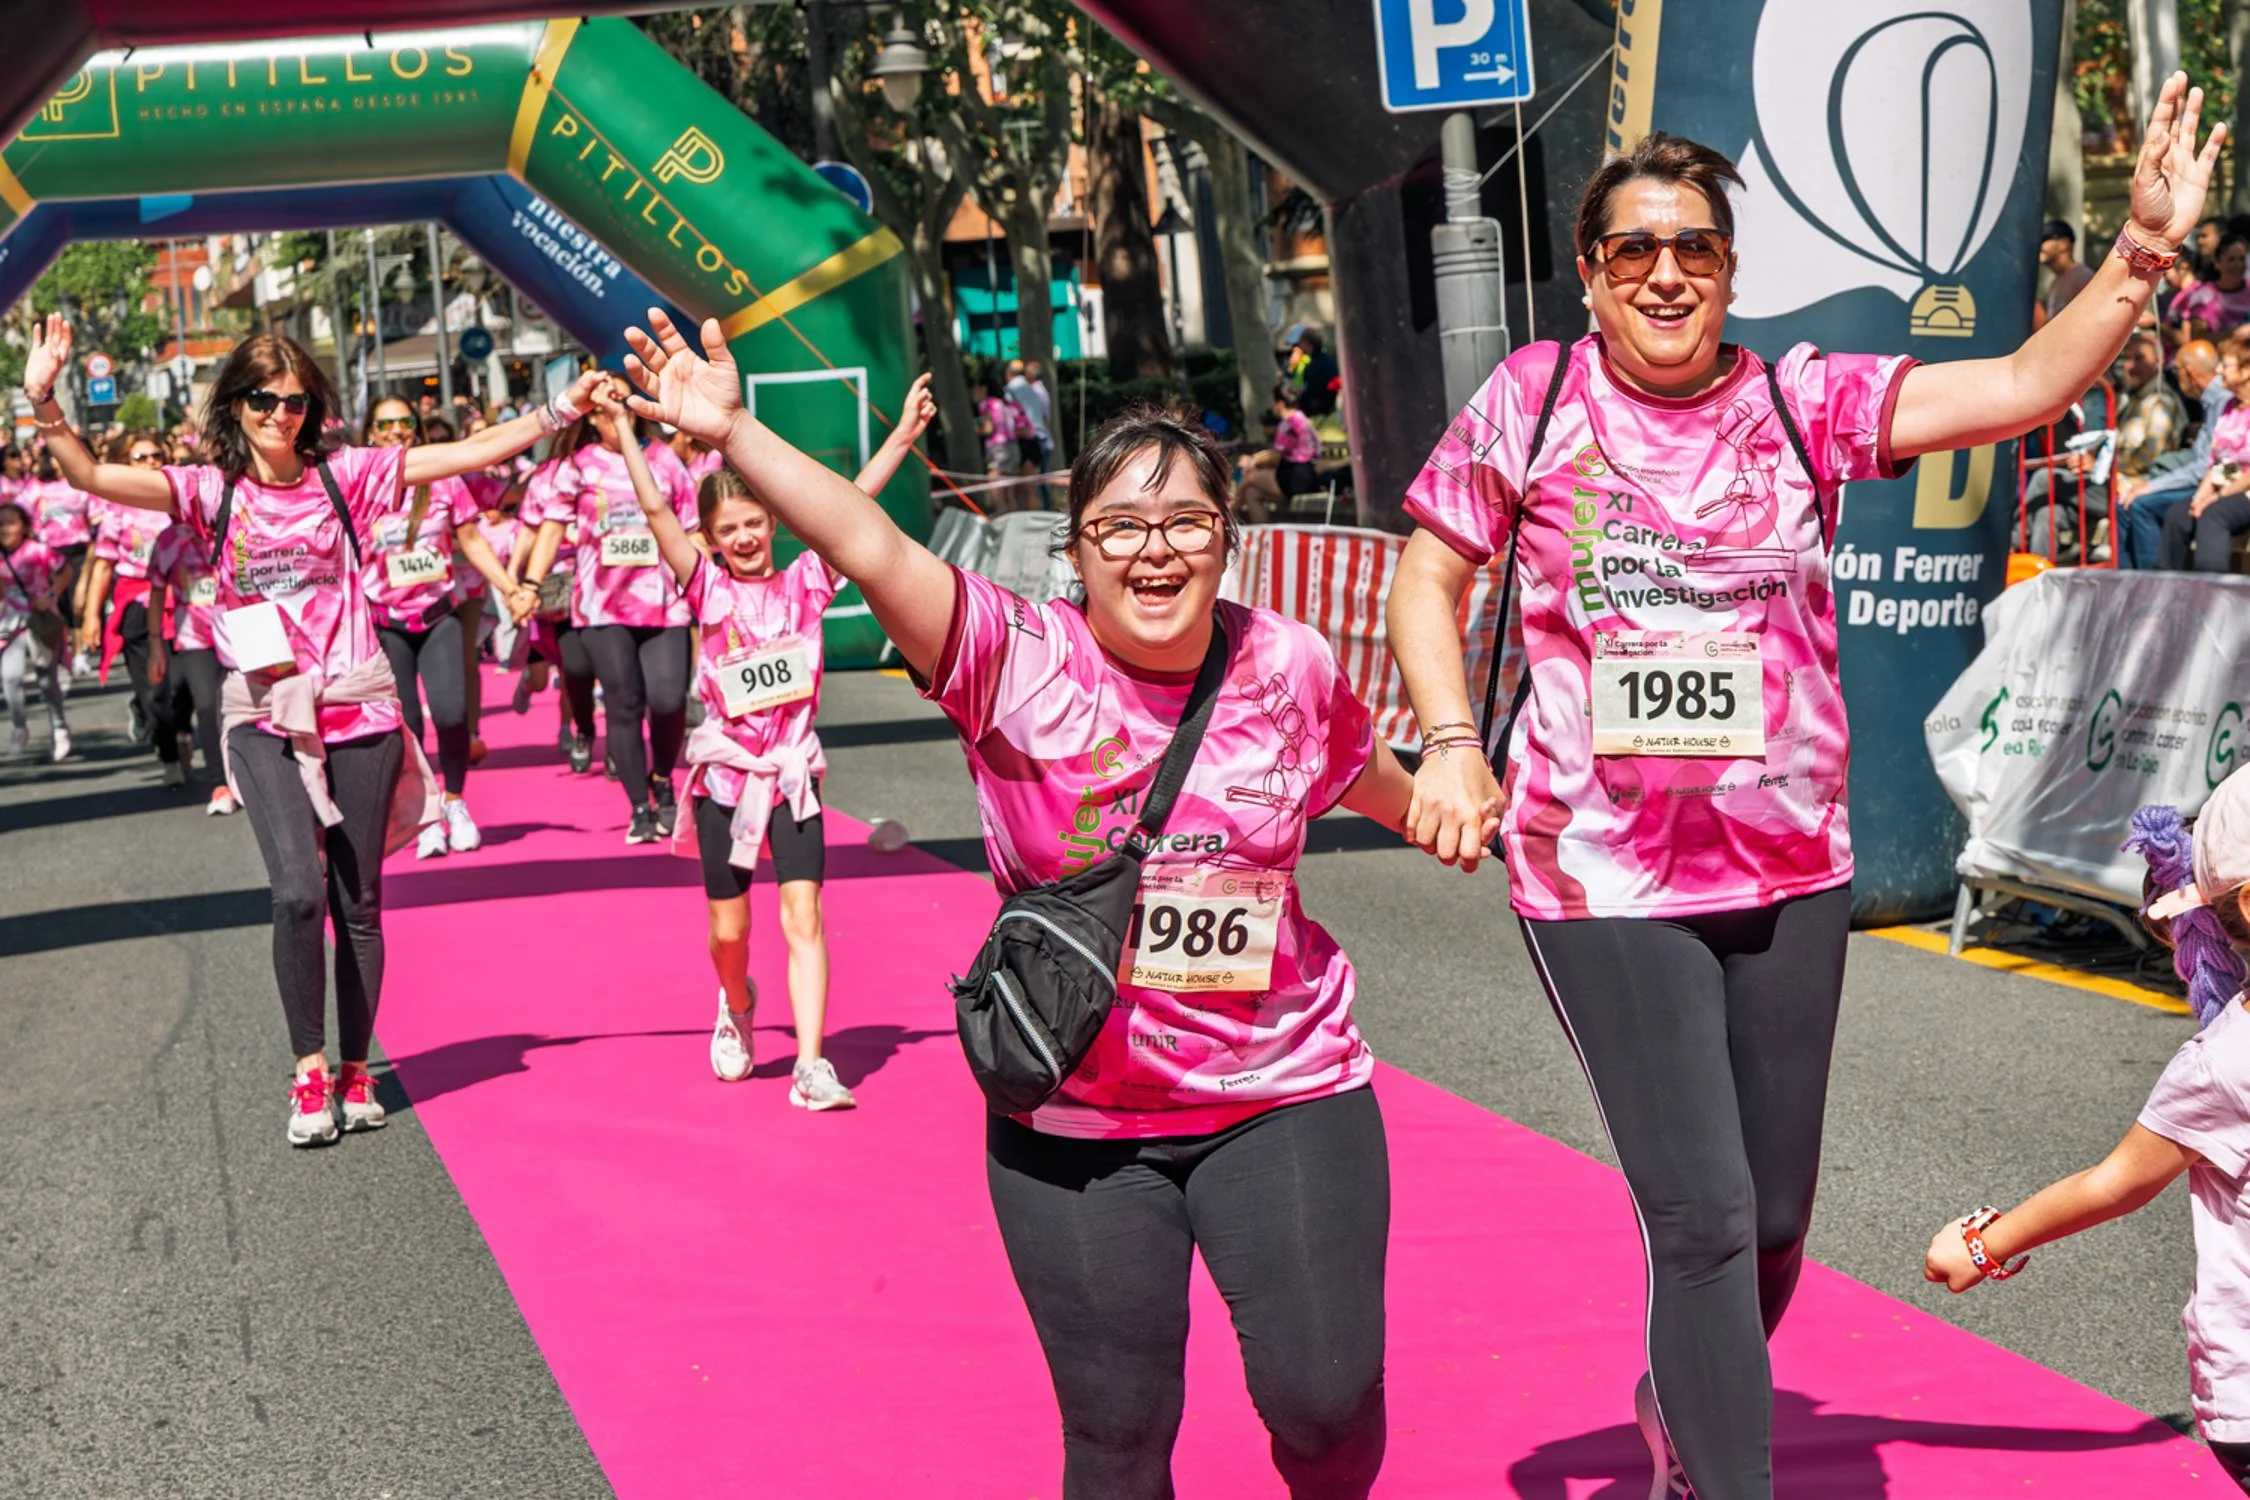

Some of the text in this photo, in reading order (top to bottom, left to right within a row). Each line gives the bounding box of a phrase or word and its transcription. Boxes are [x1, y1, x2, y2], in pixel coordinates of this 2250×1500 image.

[1408, 0, 1495, 89] P
[1470, 53, 1508, 65] 30 m
[139, 102, 208, 120] HECHO
[221, 102, 247, 116] EN
[259, 96, 341, 115] ESPAÑA
[353, 92, 420, 109] DESDE
[551, 113, 739, 296] PITILLOS
[511, 209, 606, 298] vocación.
[526, 195, 622, 280] nuestra
[1605, 491, 1632, 513] XI
[609, 538, 650, 555] 5868
[1565, 486, 1604, 612] mujer
[1603, 519, 1703, 551] Carrera
[249, 545, 305, 560] Carrera
[398, 556, 434, 574] 1414
[1601, 554, 1682, 580] por la
[1894, 547, 1983, 583] Ferrer
[250, 561, 291, 580] por la
[1604, 573, 1787, 610] Investigación
[1848, 590, 1978, 635] Deporte
[1645, 641, 1658, 649] por
[1660, 639, 1668, 647] la
[741, 658, 792, 694] 908
[1618, 670, 1736, 720] 1985
[1109, 788, 1138, 816] XI
[1128, 904, 1249, 958] 1986
